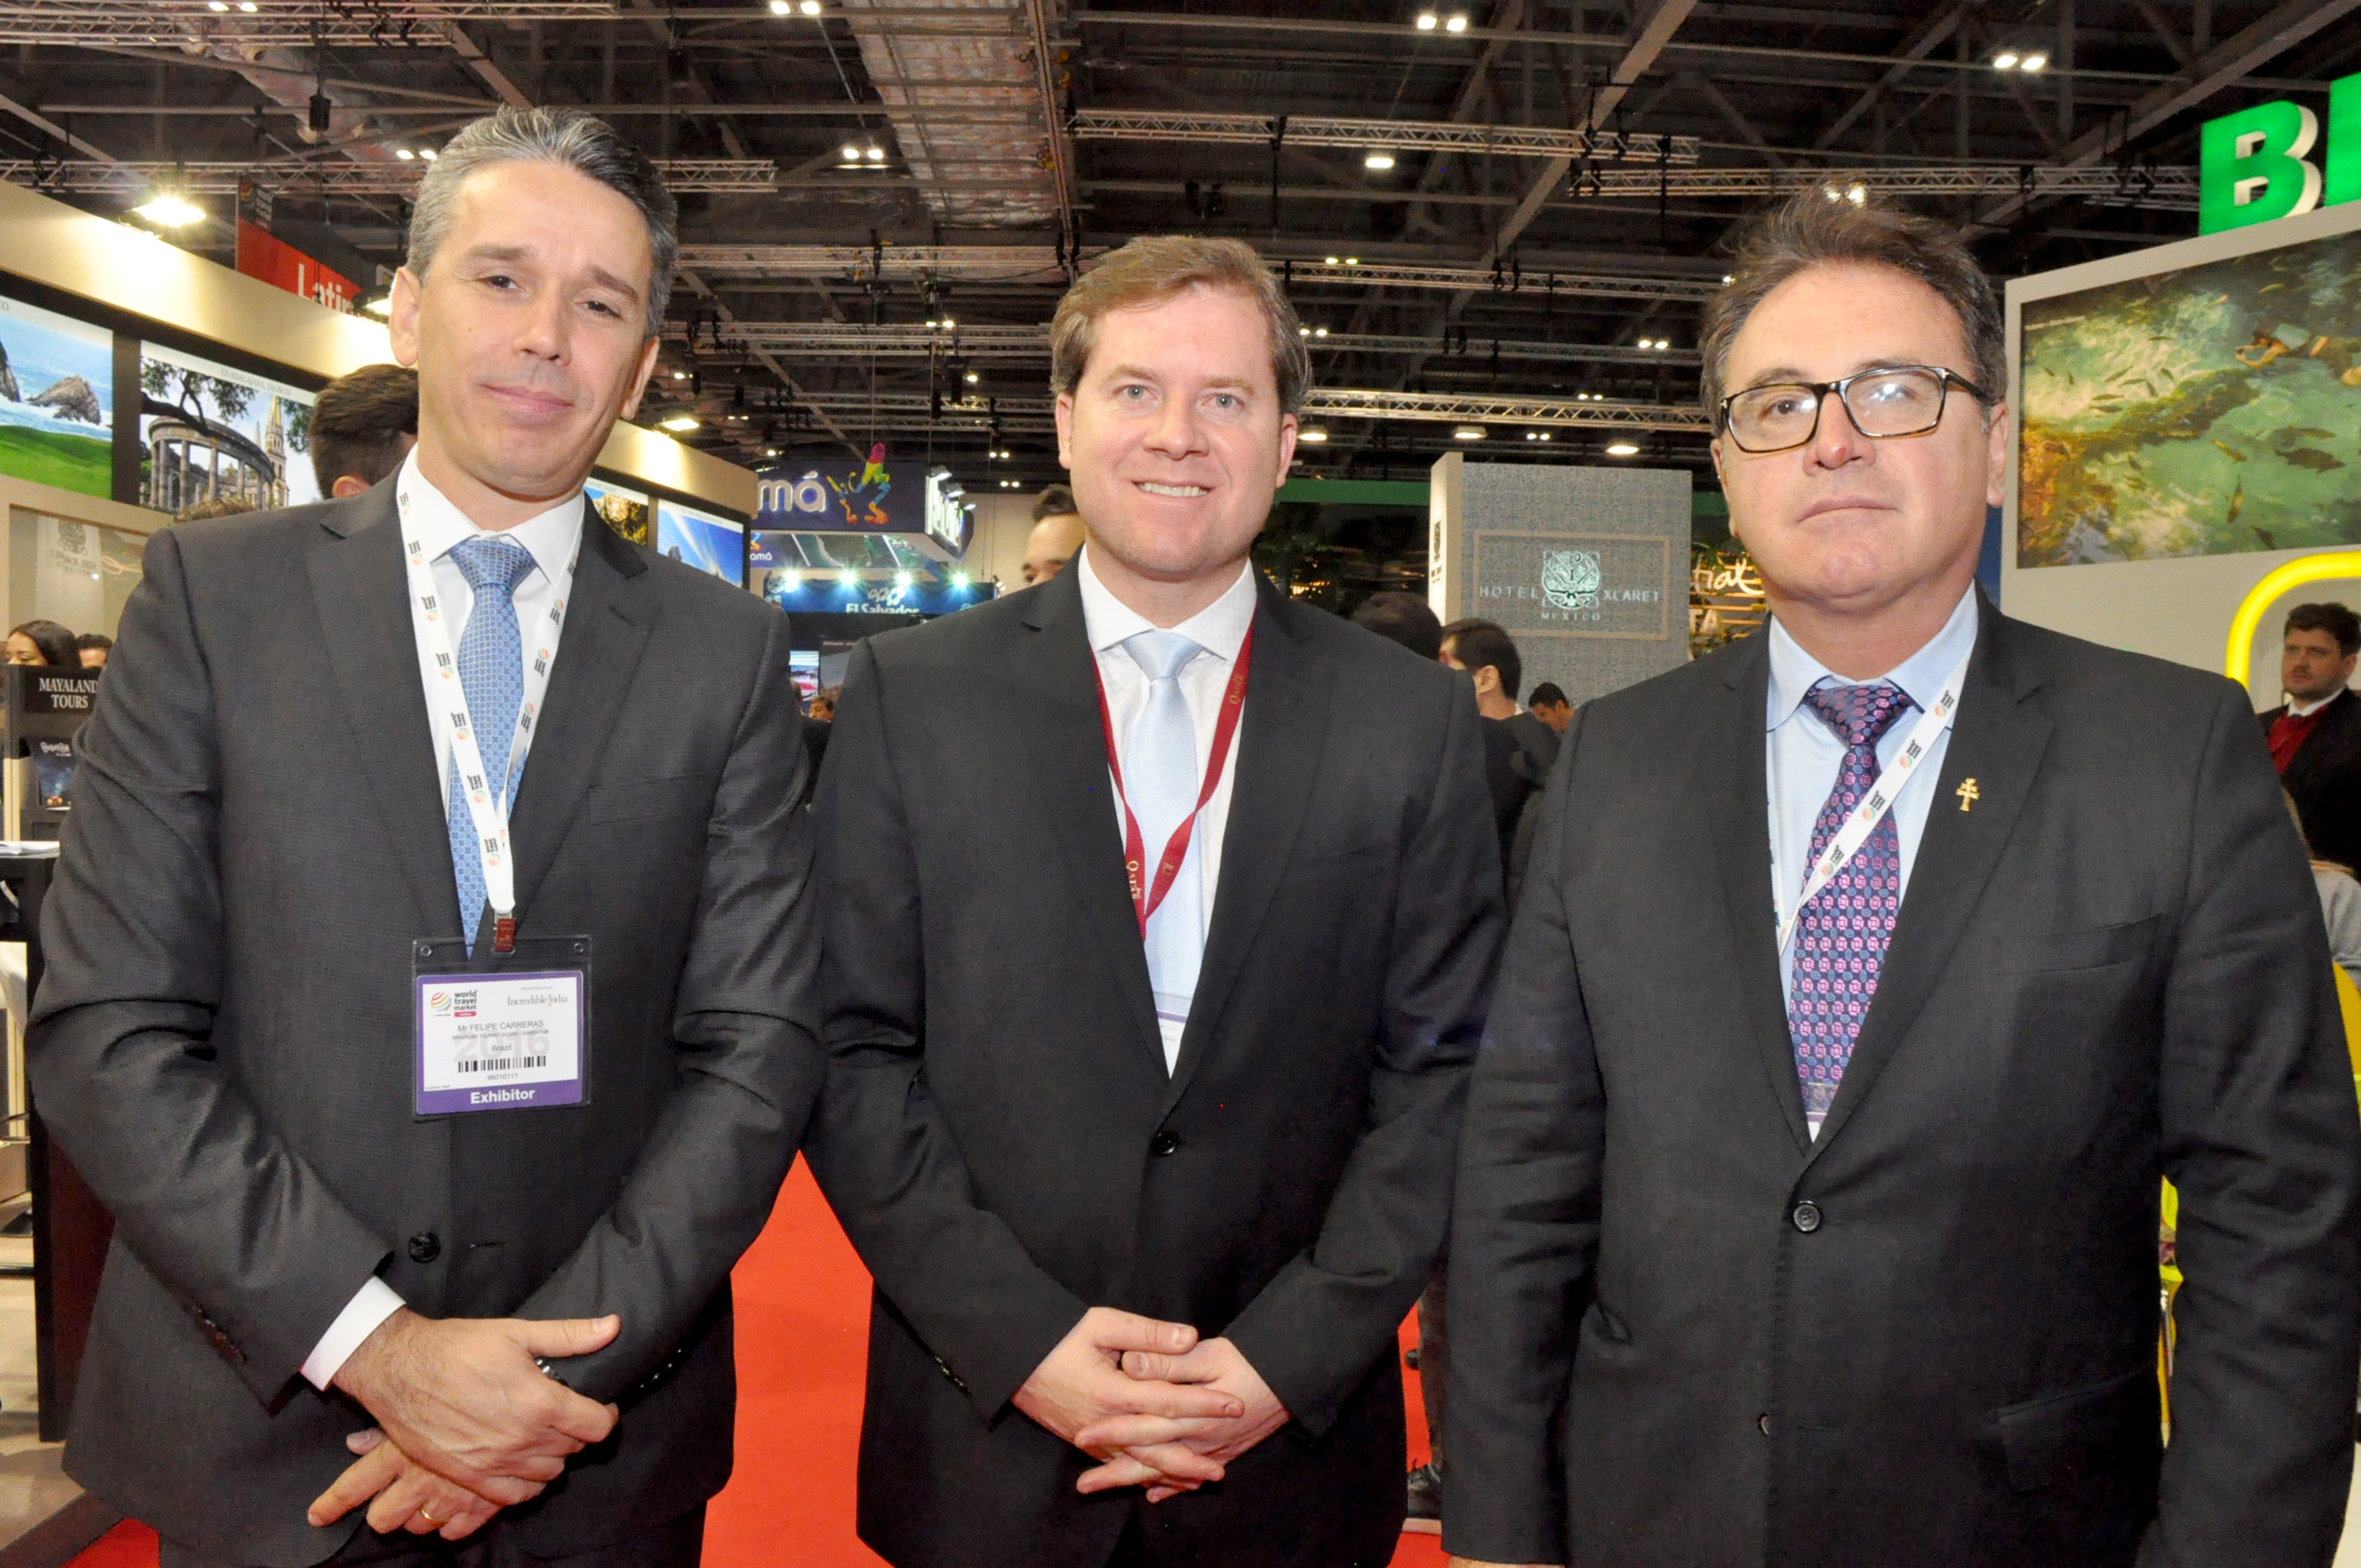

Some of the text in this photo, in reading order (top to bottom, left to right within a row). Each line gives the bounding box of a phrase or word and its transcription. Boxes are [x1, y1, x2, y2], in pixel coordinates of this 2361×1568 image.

[1479, 586, 1661, 602] HOTEL XCARET
[861, 603, 920, 614] Salvador
[1541, 611, 1600, 622] MEXICO
[39, 678, 98, 694] MAYALAND
[51, 694, 88, 708] TOURS
[454, 990, 476, 998] world
[470, 1023, 498, 1031] FELIPE
[500, 1020, 544, 1030] CARRERAS
[470, 1089, 535, 1104] Exhibitor
